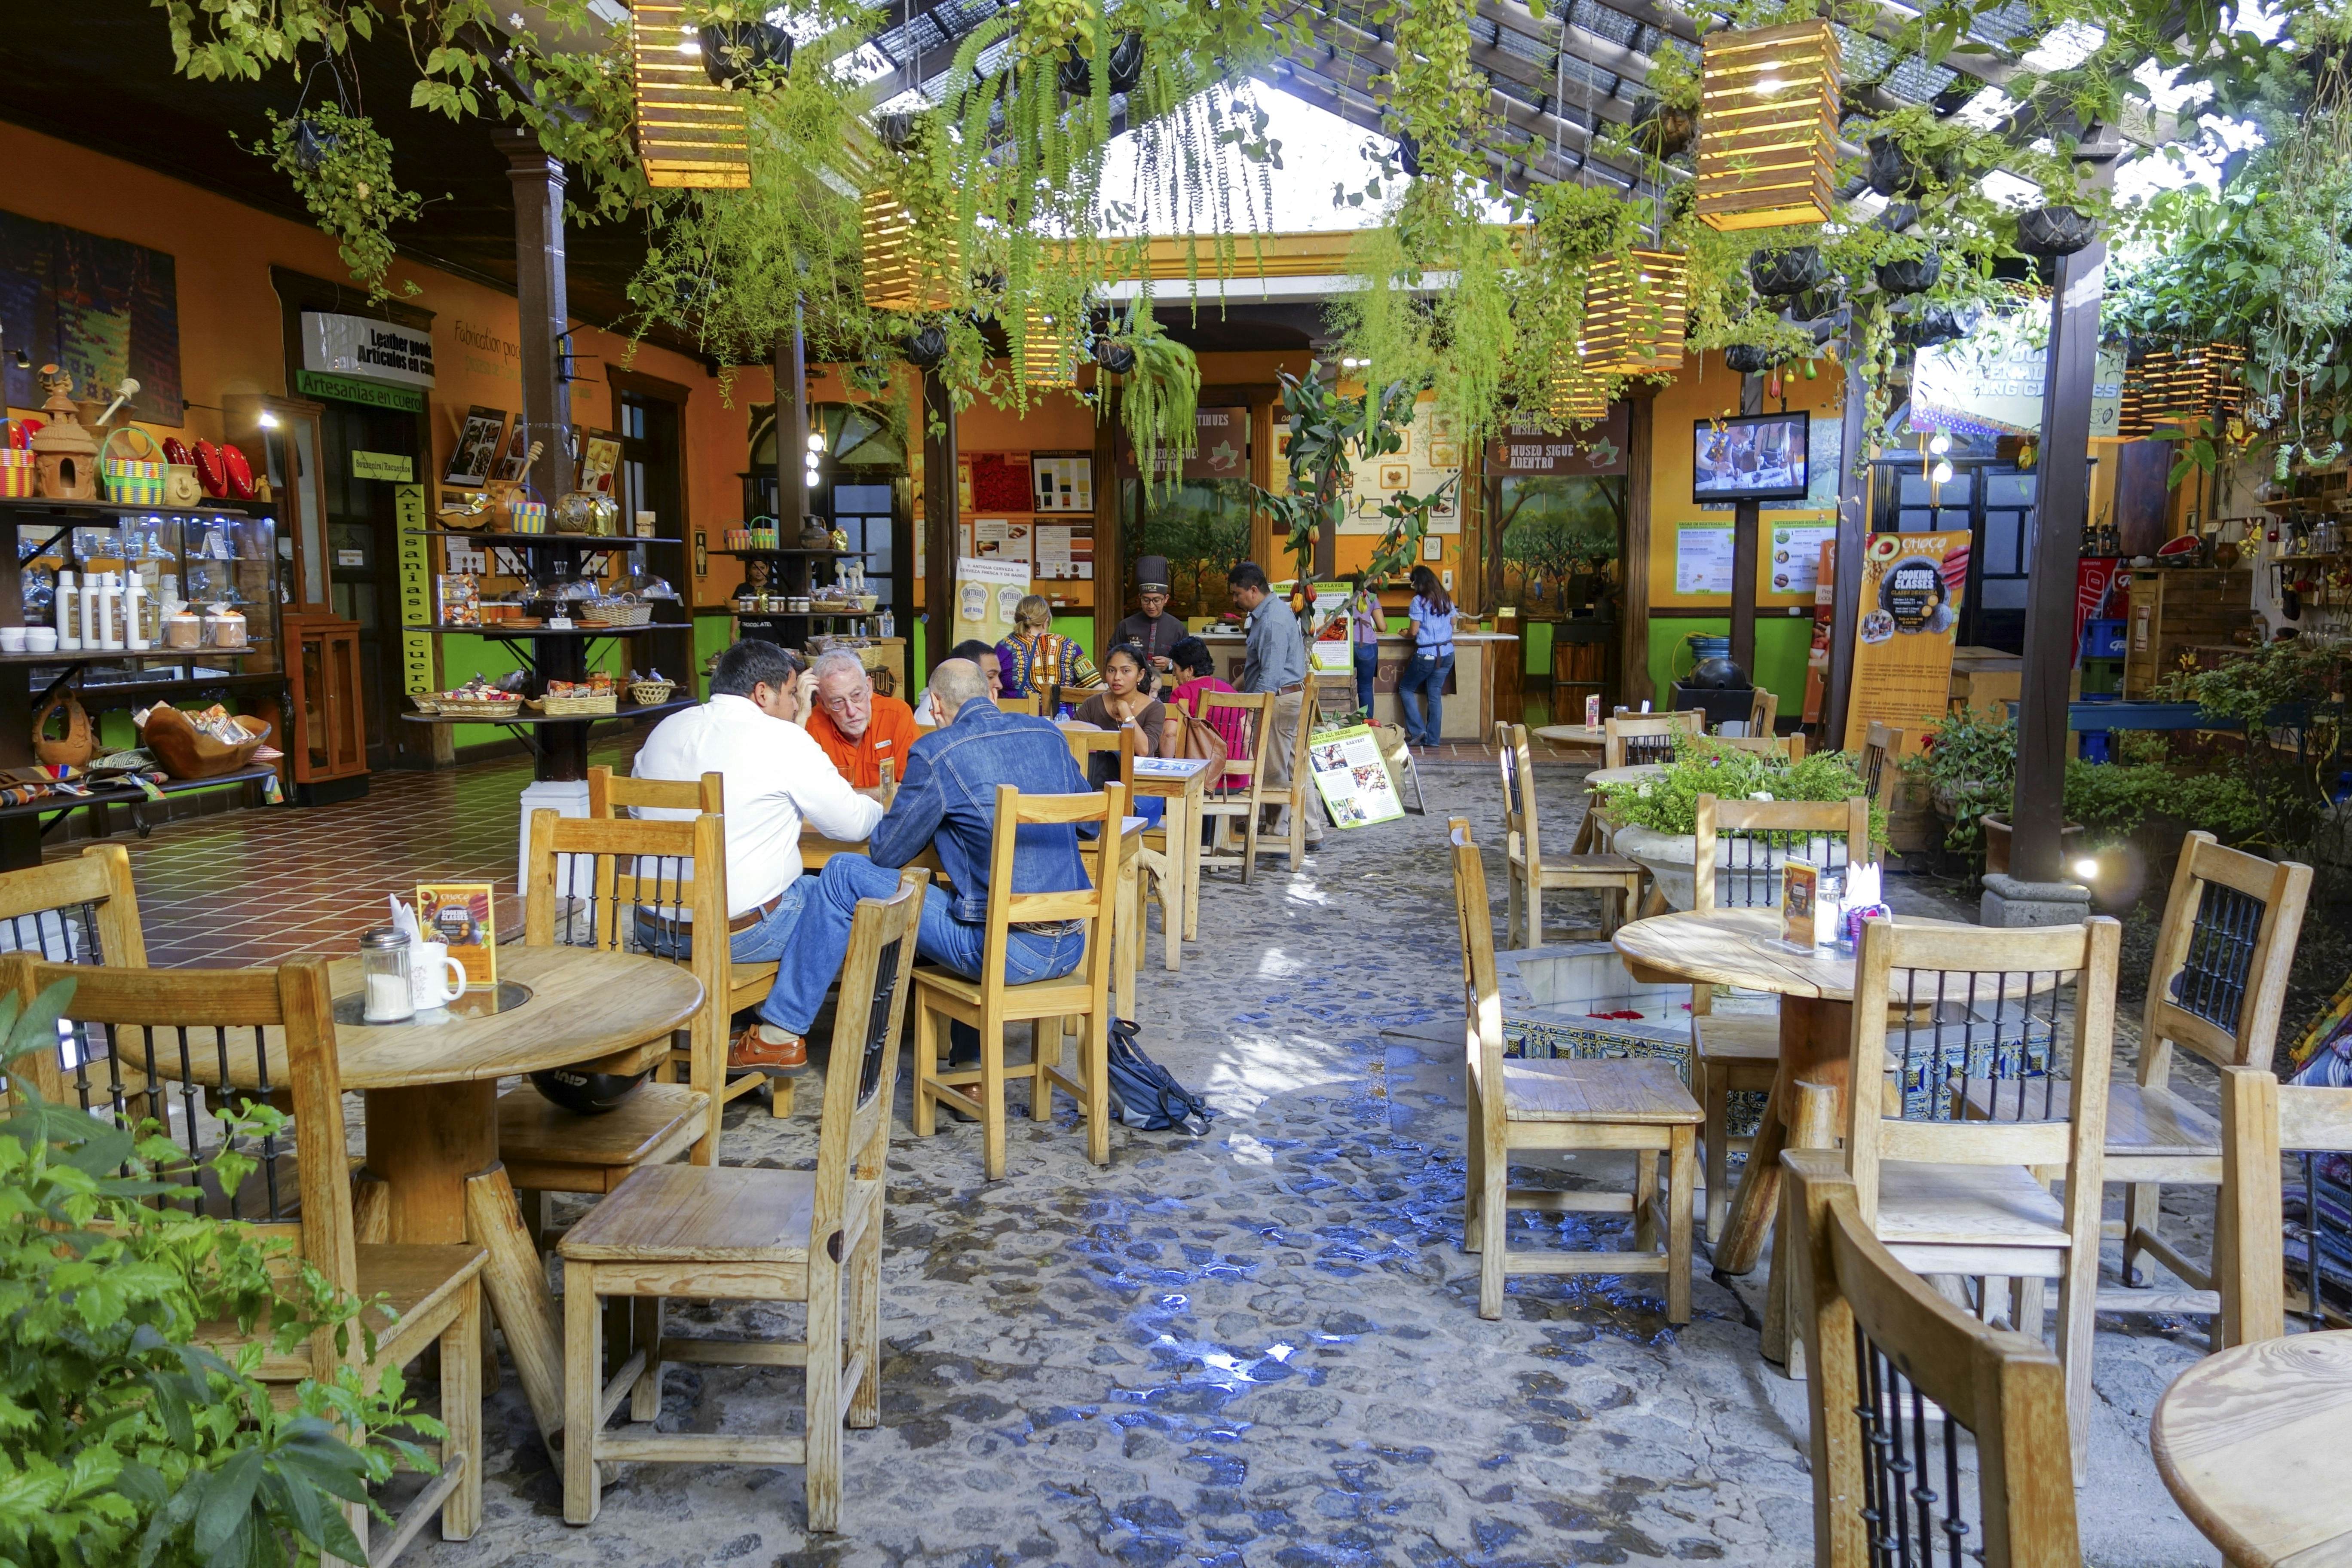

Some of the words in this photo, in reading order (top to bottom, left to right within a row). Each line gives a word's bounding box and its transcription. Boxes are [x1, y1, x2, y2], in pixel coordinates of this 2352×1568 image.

[371, 328, 408, 352] Leather
[454, 320, 501, 353] Fabrication
[408, 358, 419, 373] en
[377, 392, 391, 406] en
[393, 394, 422, 410] cuero
[1510, 444, 1542, 456] MUSEO
[1546, 444, 1573, 456] SIGUE
[1510, 456, 1554, 469] ADENTRO
[1902, 537, 1947, 549] CHOCO
[1896, 570, 1934, 579] COOKING
[1894, 579, 1934, 590] CLASSES
[962, 587, 986, 604] ANTIGUA
[407, 639, 427, 694] cuero
